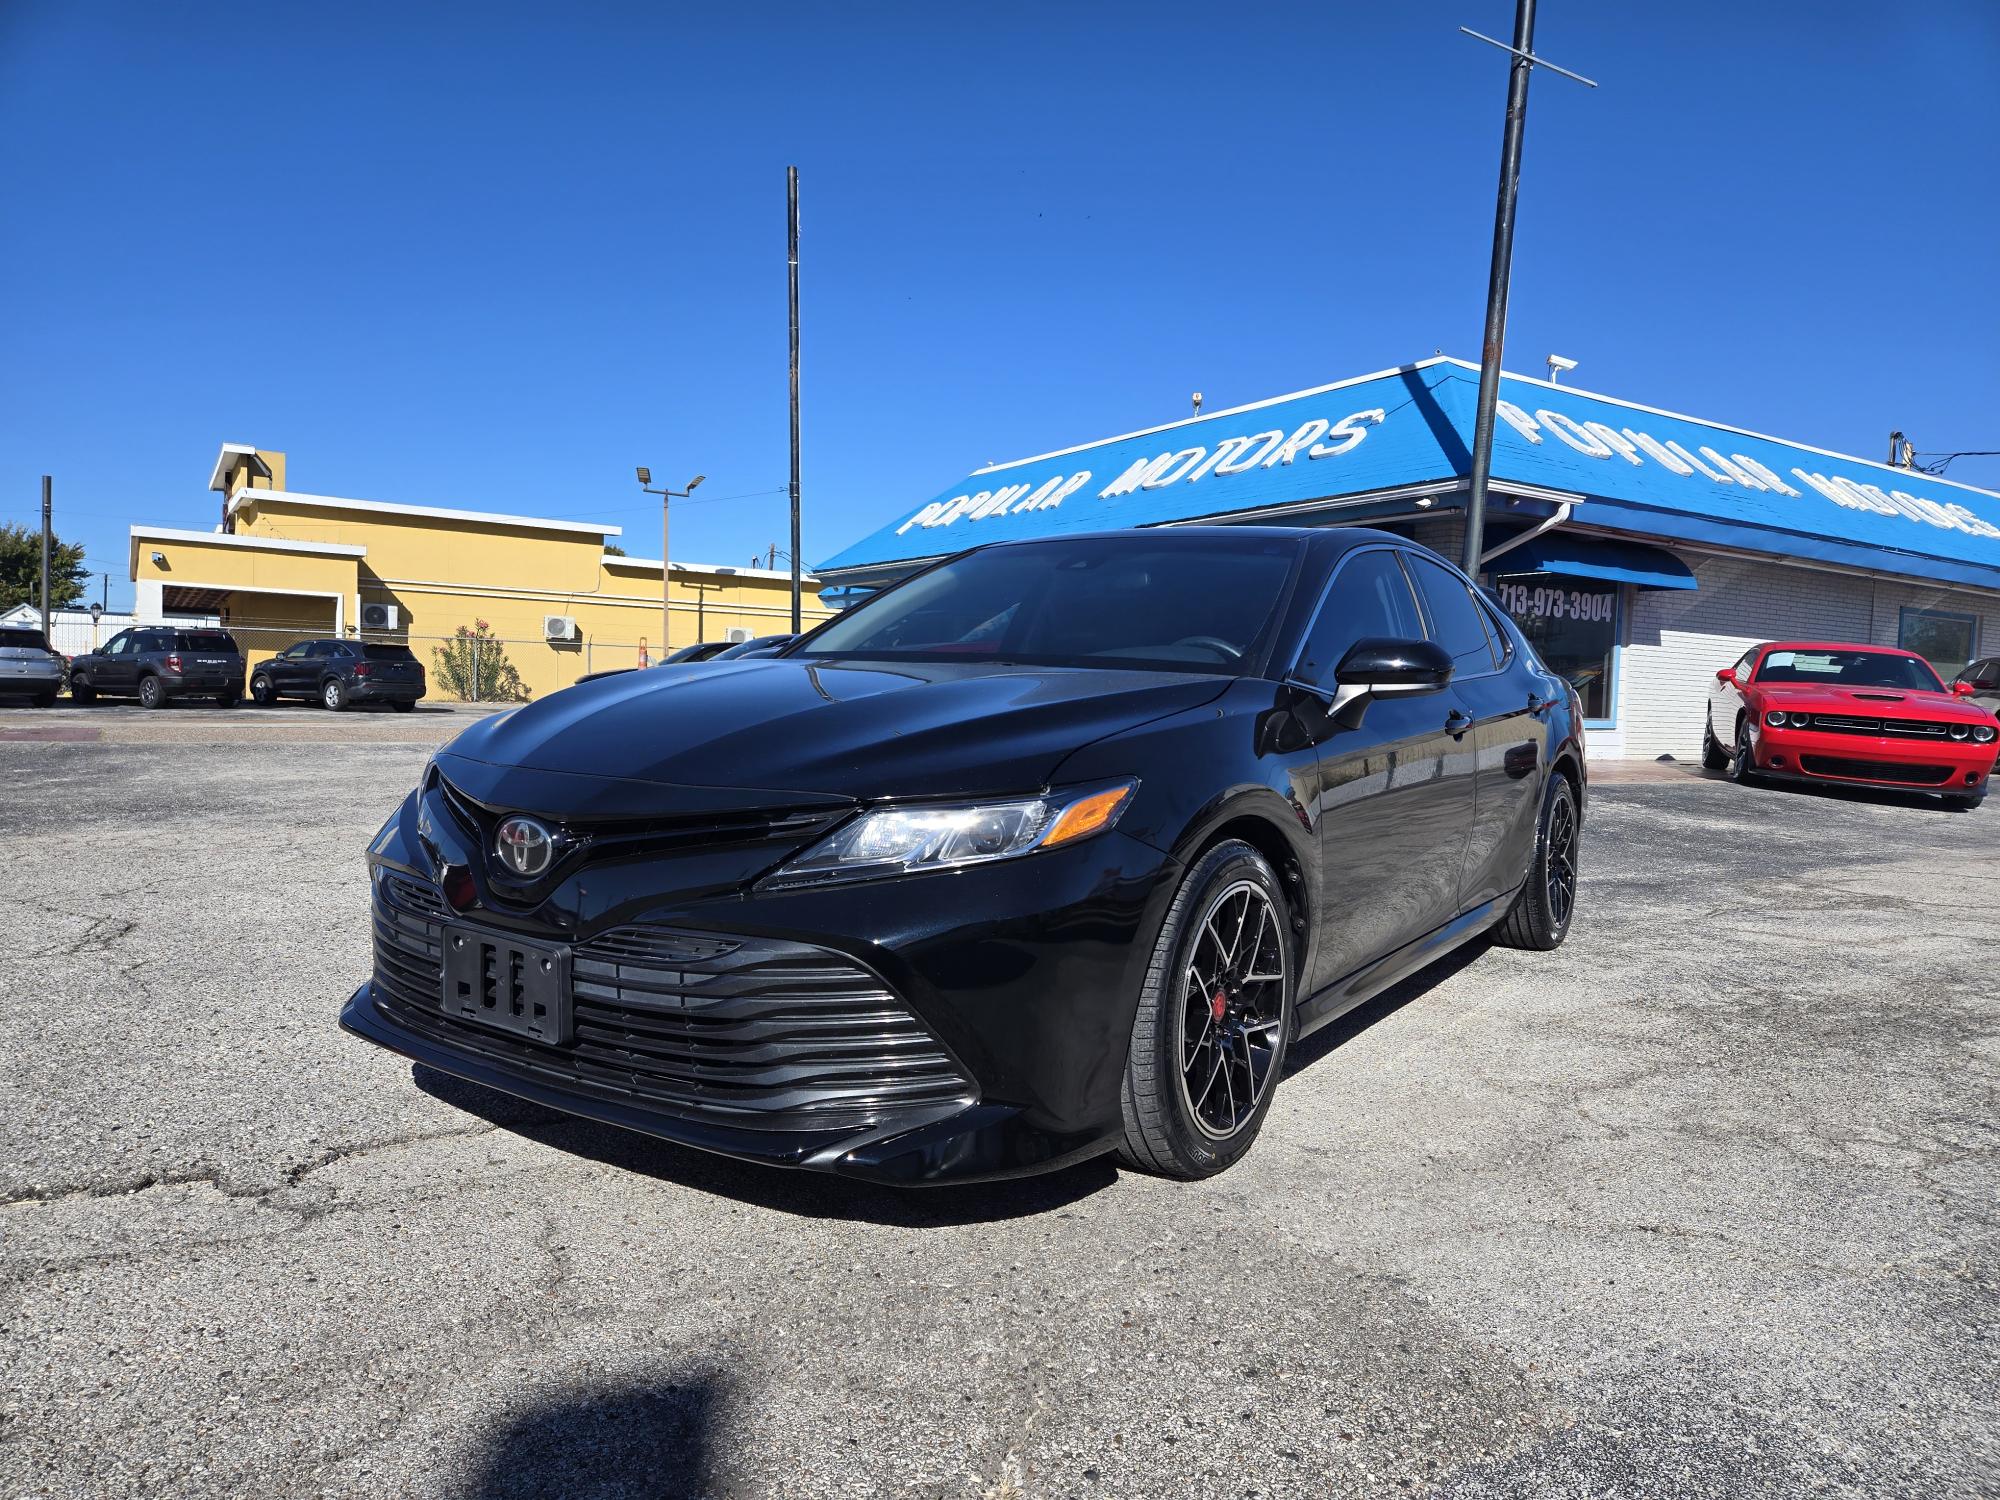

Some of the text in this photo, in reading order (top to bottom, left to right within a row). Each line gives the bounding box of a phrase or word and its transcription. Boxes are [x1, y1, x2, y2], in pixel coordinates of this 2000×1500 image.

[895, 408, 1386, 536] POPULAR MOTORS
[1495, 399, 1802, 498] POPULAR
[1500, 583, 1614, 622] 713-973-3904
